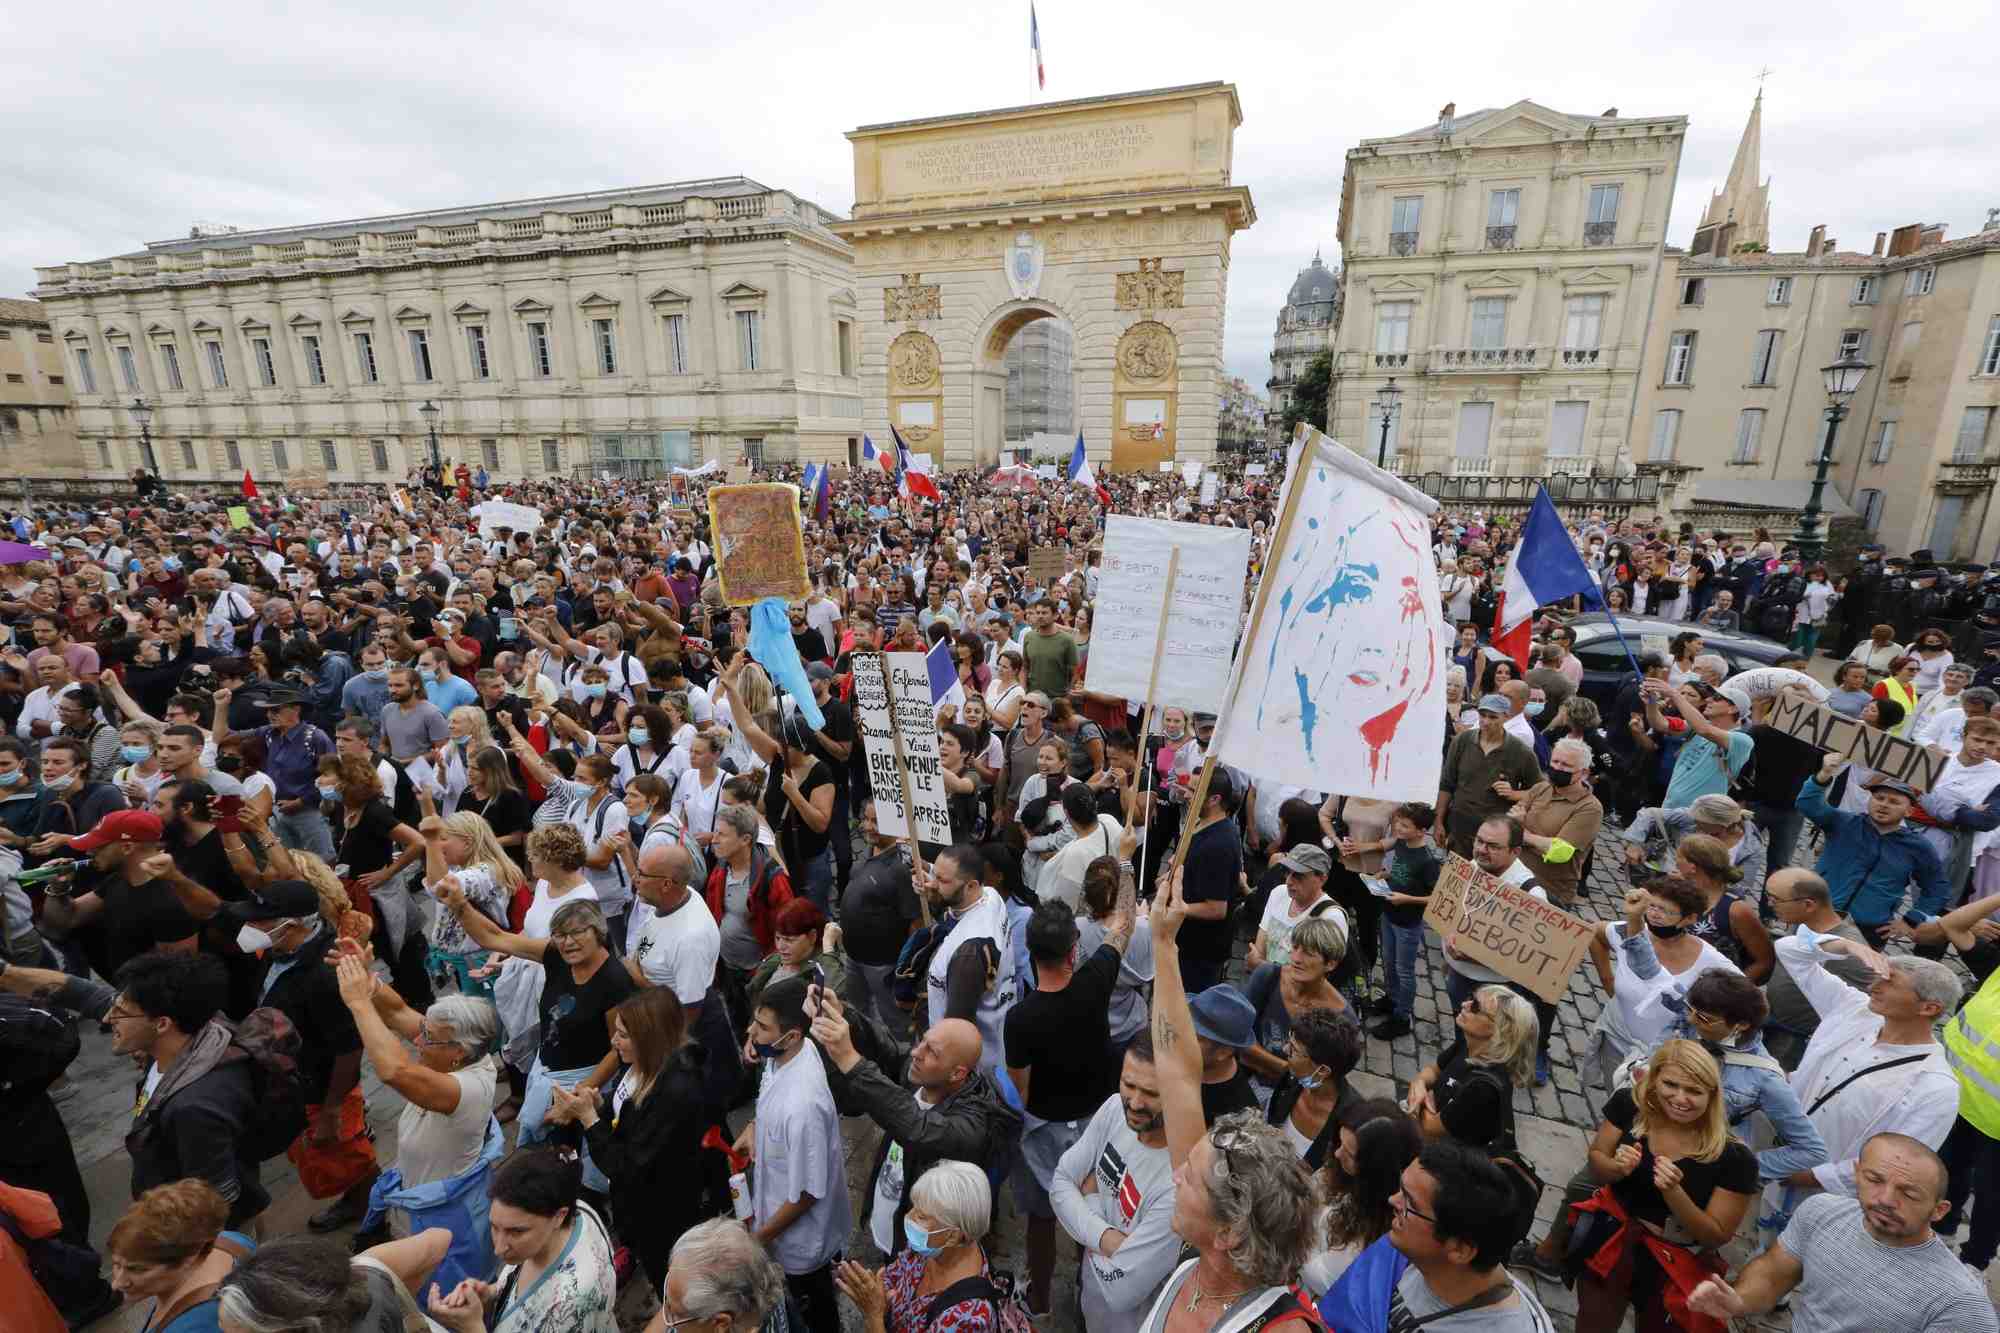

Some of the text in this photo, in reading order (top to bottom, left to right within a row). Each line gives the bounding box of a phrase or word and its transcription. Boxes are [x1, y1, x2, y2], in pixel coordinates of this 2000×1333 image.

[872, 771, 932, 792] DANS LE
[872, 786, 905, 804] MONDE
[1456, 914, 1559, 975] DEBOUT
